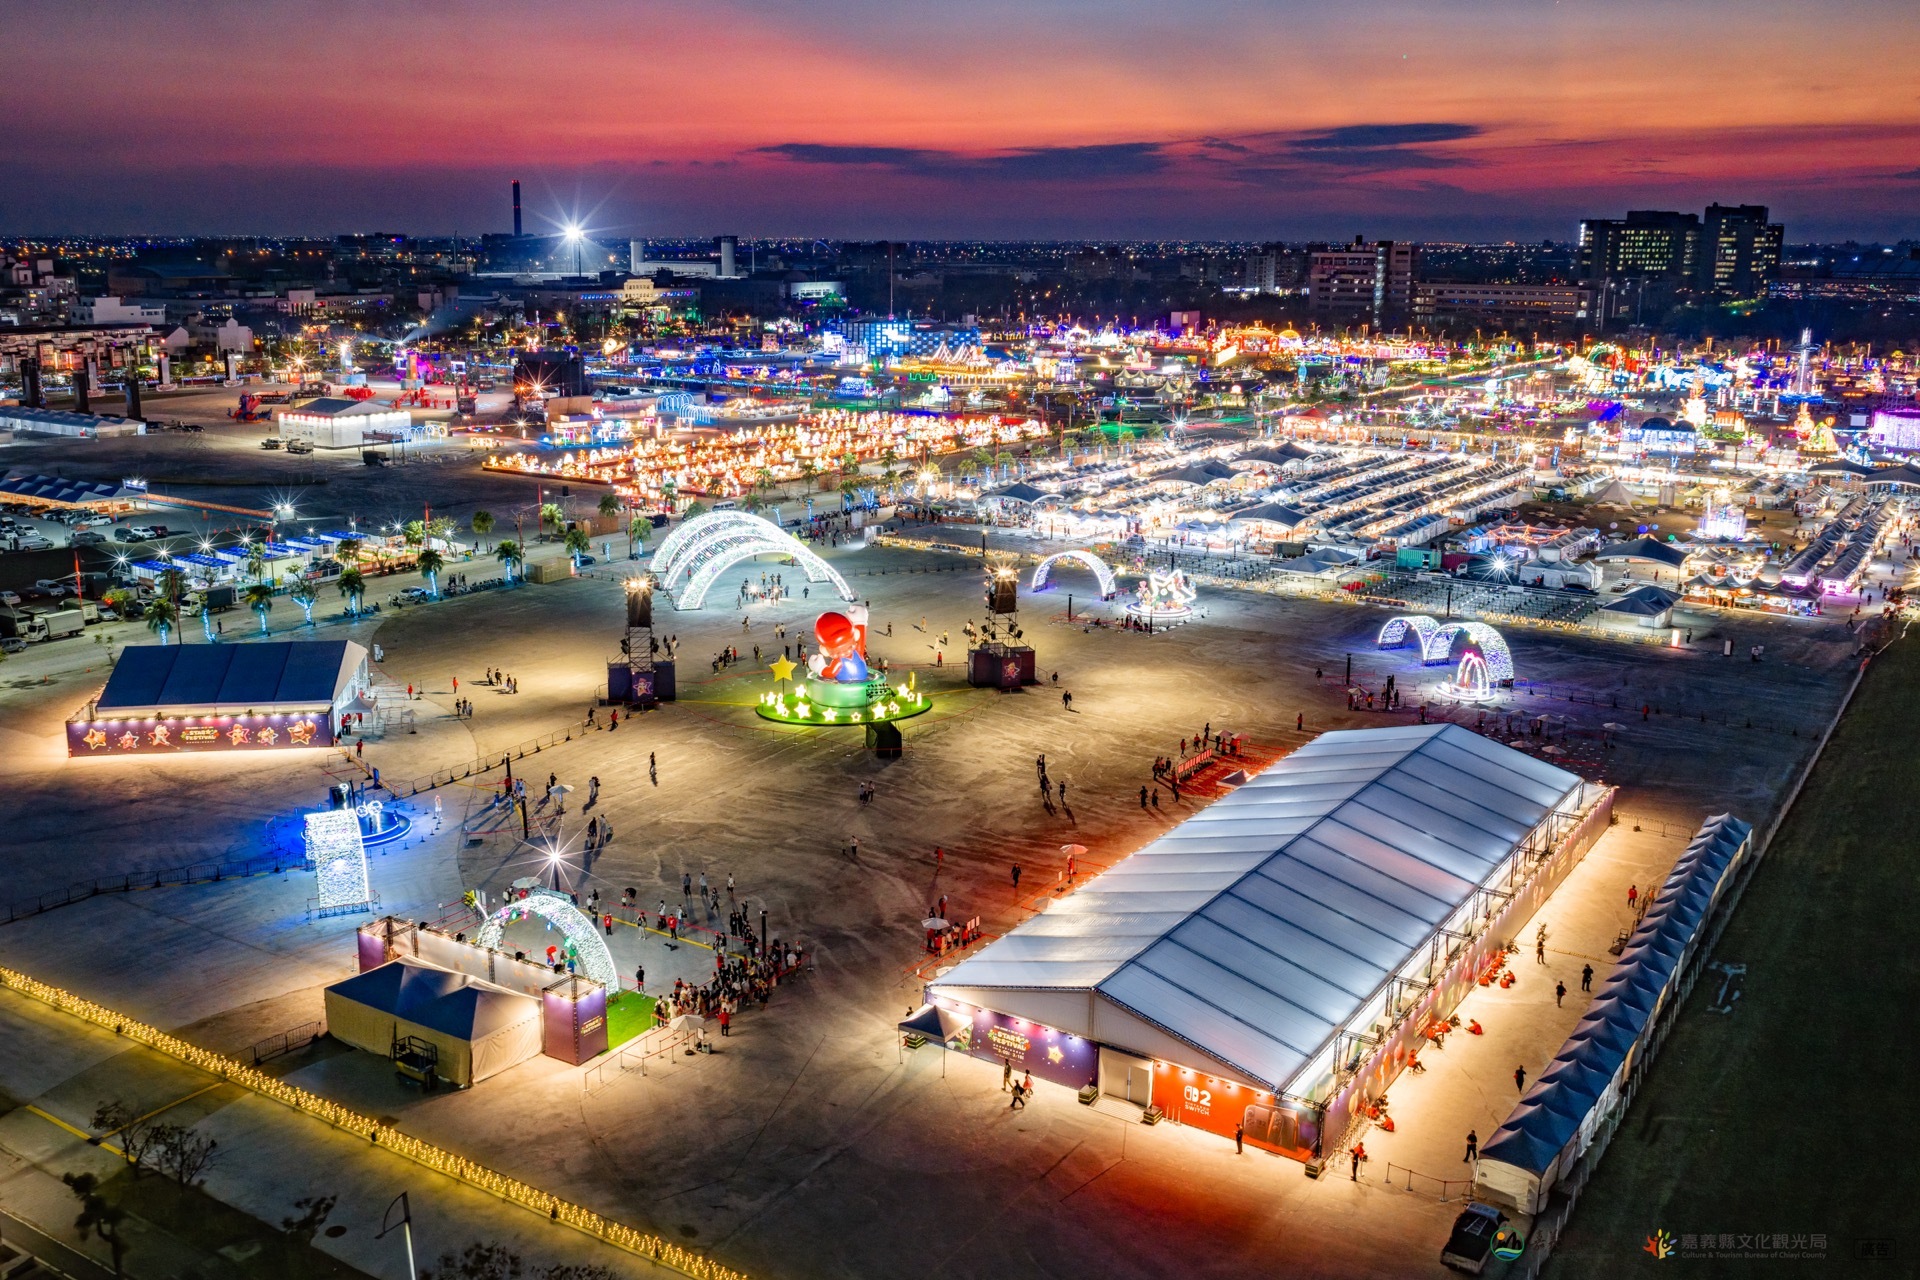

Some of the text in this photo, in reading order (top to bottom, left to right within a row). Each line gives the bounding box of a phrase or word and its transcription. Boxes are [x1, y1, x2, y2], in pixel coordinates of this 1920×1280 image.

[993, 1036, 1026, 1051] FESTIVAL
[1200, 1090, 1211, 1107] 2
[1185, 1105, 1210, 1116] SWITCH
